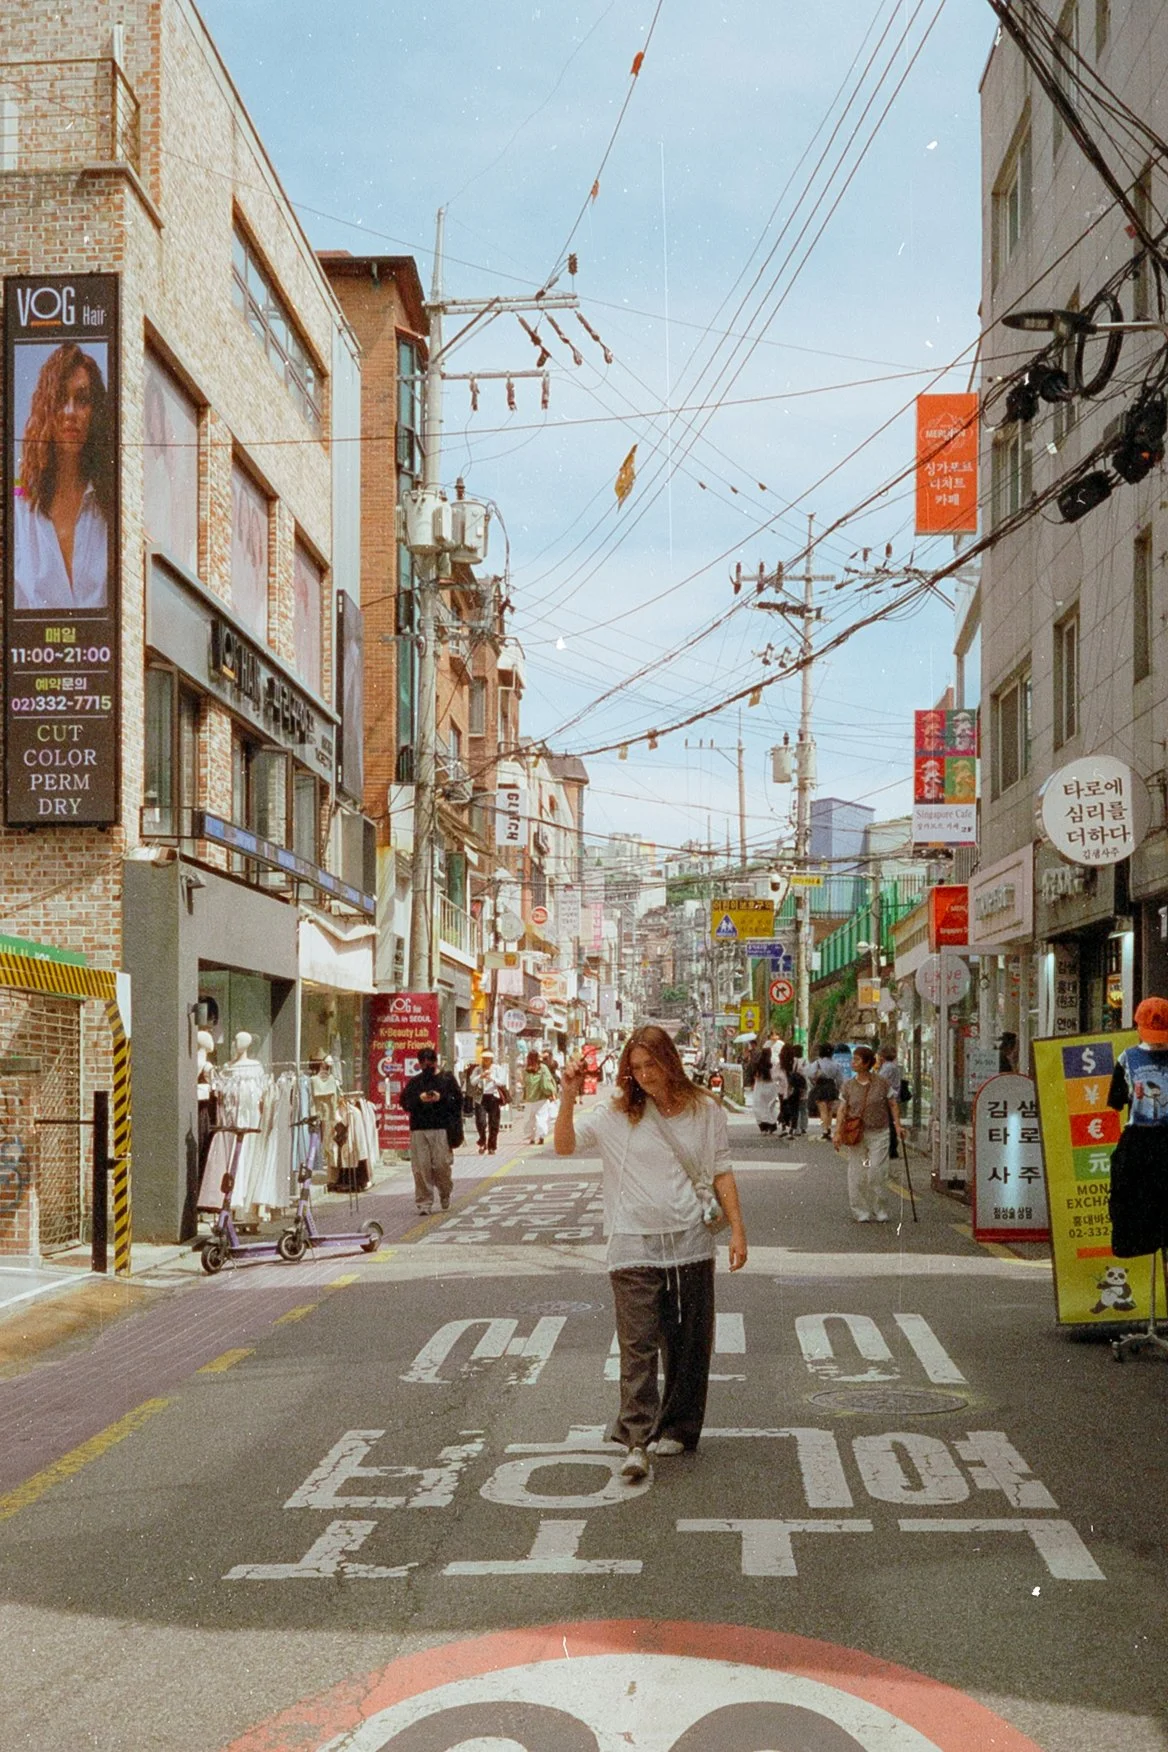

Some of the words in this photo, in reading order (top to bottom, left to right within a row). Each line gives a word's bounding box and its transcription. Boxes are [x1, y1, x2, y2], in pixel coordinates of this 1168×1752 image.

[16, 286, 76, 327] VOG
[83, 304, 105, 326] Hair
[935, 494, 960, 506] 카페
[45, 627, 77, 643] 매일
[11, 646, 111, 663] 11:00~21:00
[35, 677, 88, 691] 예약문의
[11, 695, 112, 711] 02)332-7715
[37, 724, 84, 742] CUT
[23, 749, 97, 766] COLOR
[30, 773, 91, 791] PERM
[1063, 777, 1124, 799] 타로에
[38, 798, 82, 815] DRY
[916, 809, 954, 820] Singapore
[955, 808, 973, 818] Cafe
[1065, 801, 1128, 823] 심리를
[1066, 824, 1131, 847] 더하다
[409, 1015, 432, 1023] SEOUL
[1057, 1017, 1077, 1031] 연애
[415, 1027, 429, 1037] Lab
[1081, 1047, 1097, 1074] $
[1087, 1118, 1104, 1139] €
[1077, 1183, 1111, 1195] MON
[1066, 1196, 1111, 1210] EXCHA
[1017, 1207, 1033, 1220] 상담
